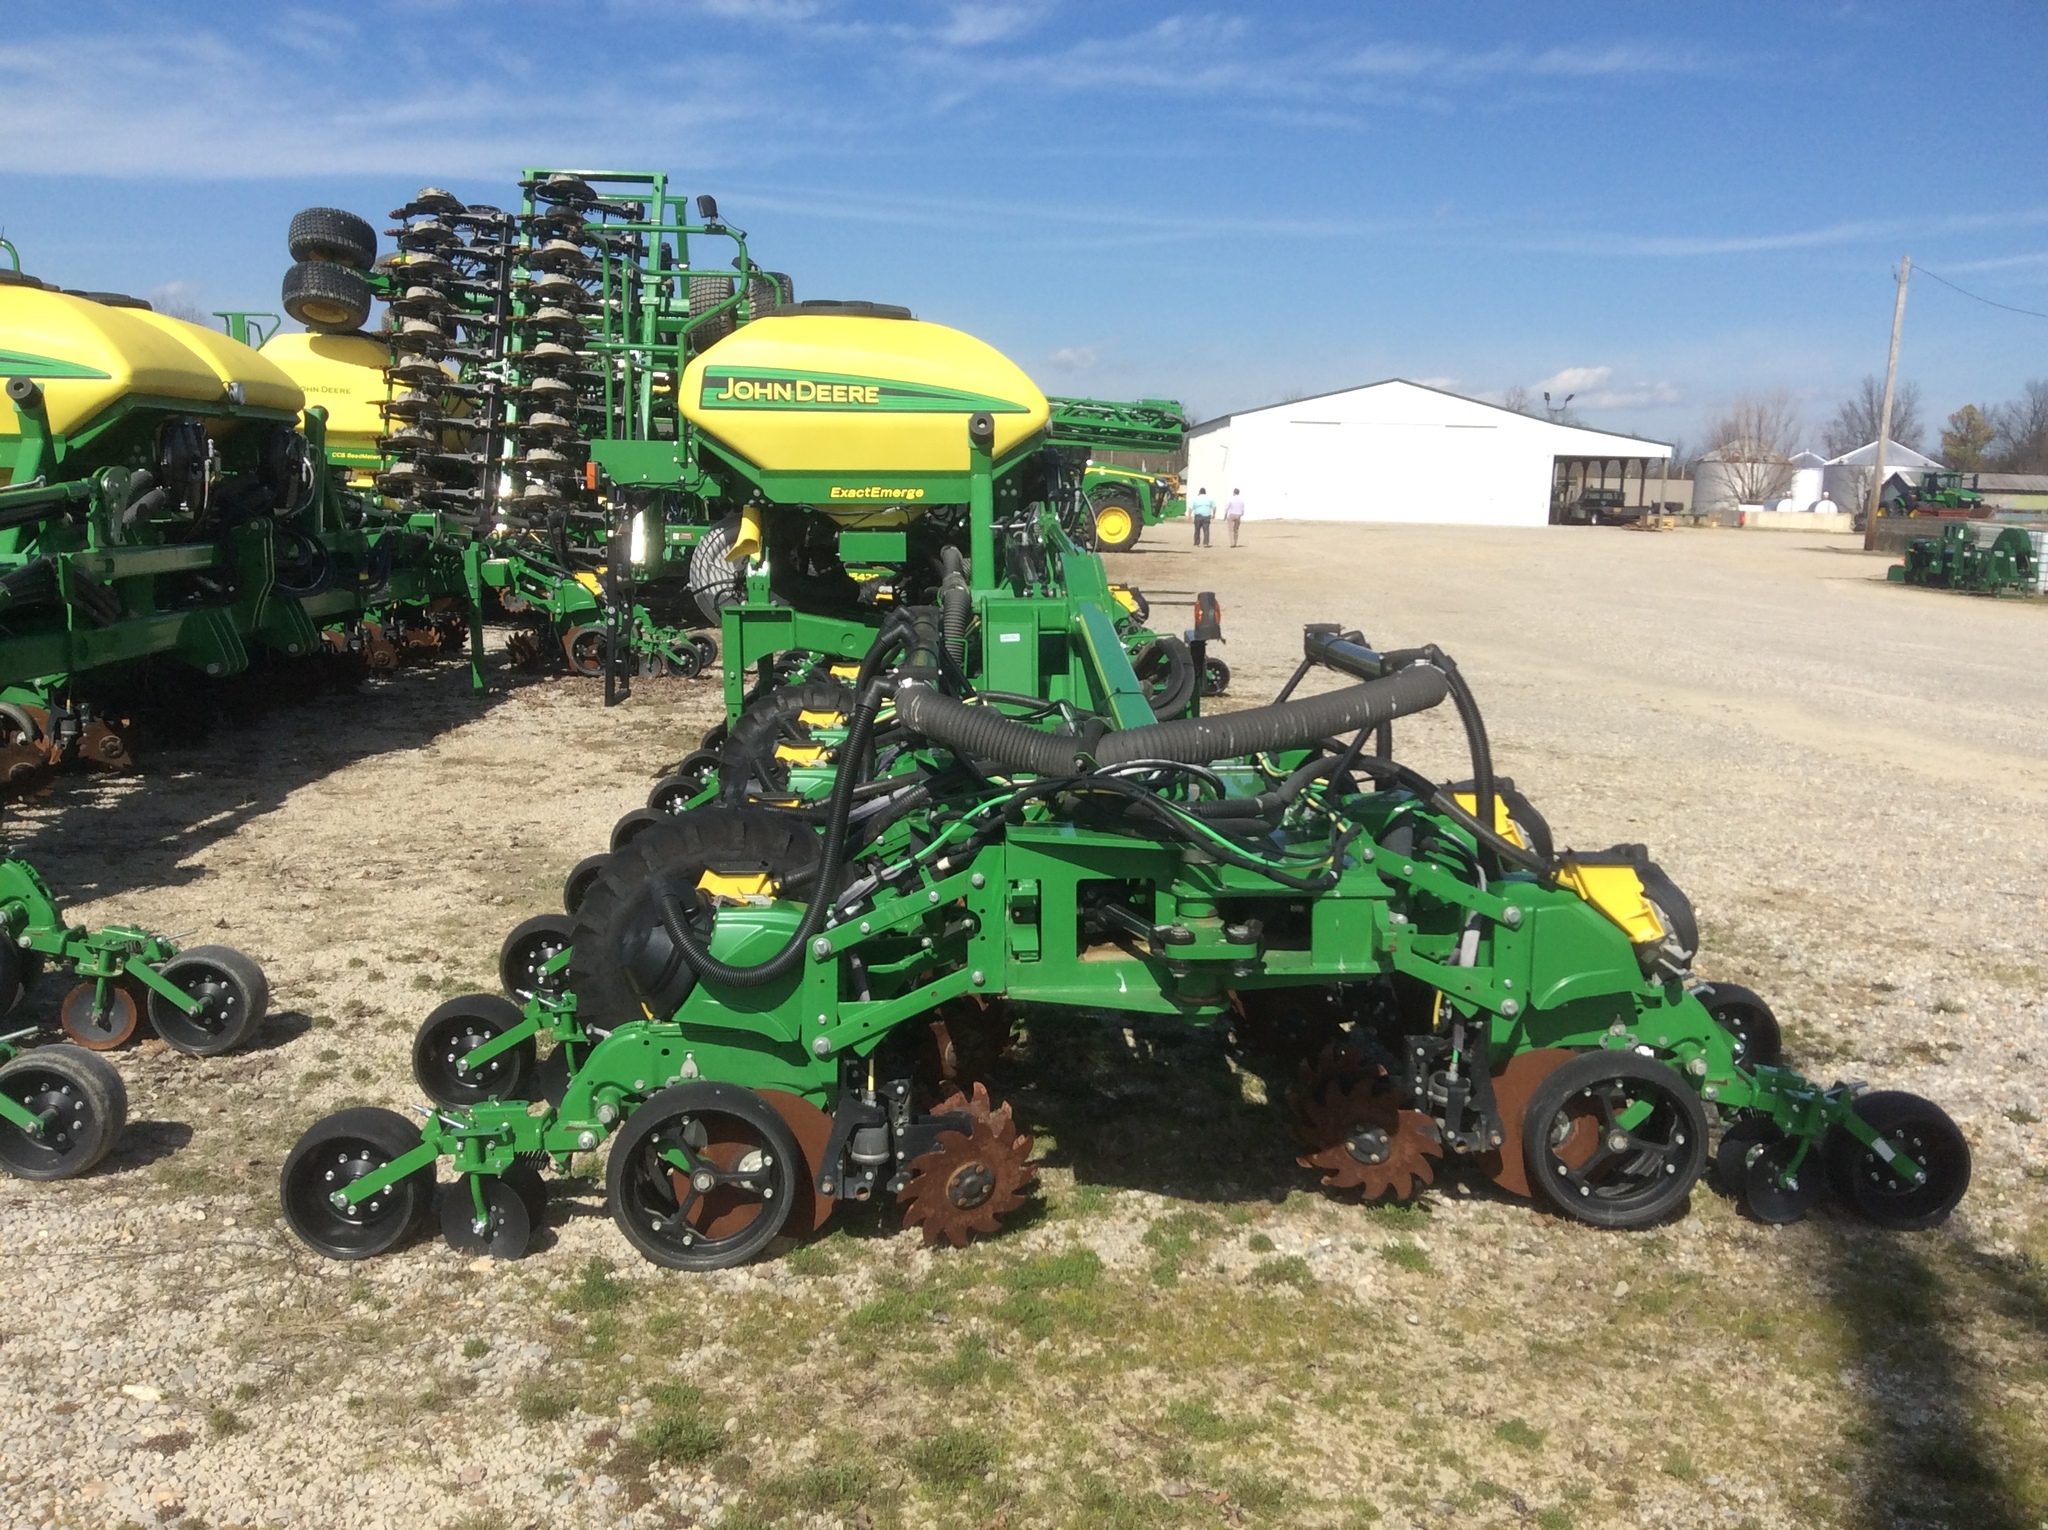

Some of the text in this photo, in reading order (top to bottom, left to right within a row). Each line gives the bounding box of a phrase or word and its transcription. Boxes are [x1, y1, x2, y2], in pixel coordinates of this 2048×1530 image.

[321, 386, 351, 394] DEERE
[717, 377, 879, 403] JOHN DEERE
[830, 486, 924, 500] ExactEmerge
